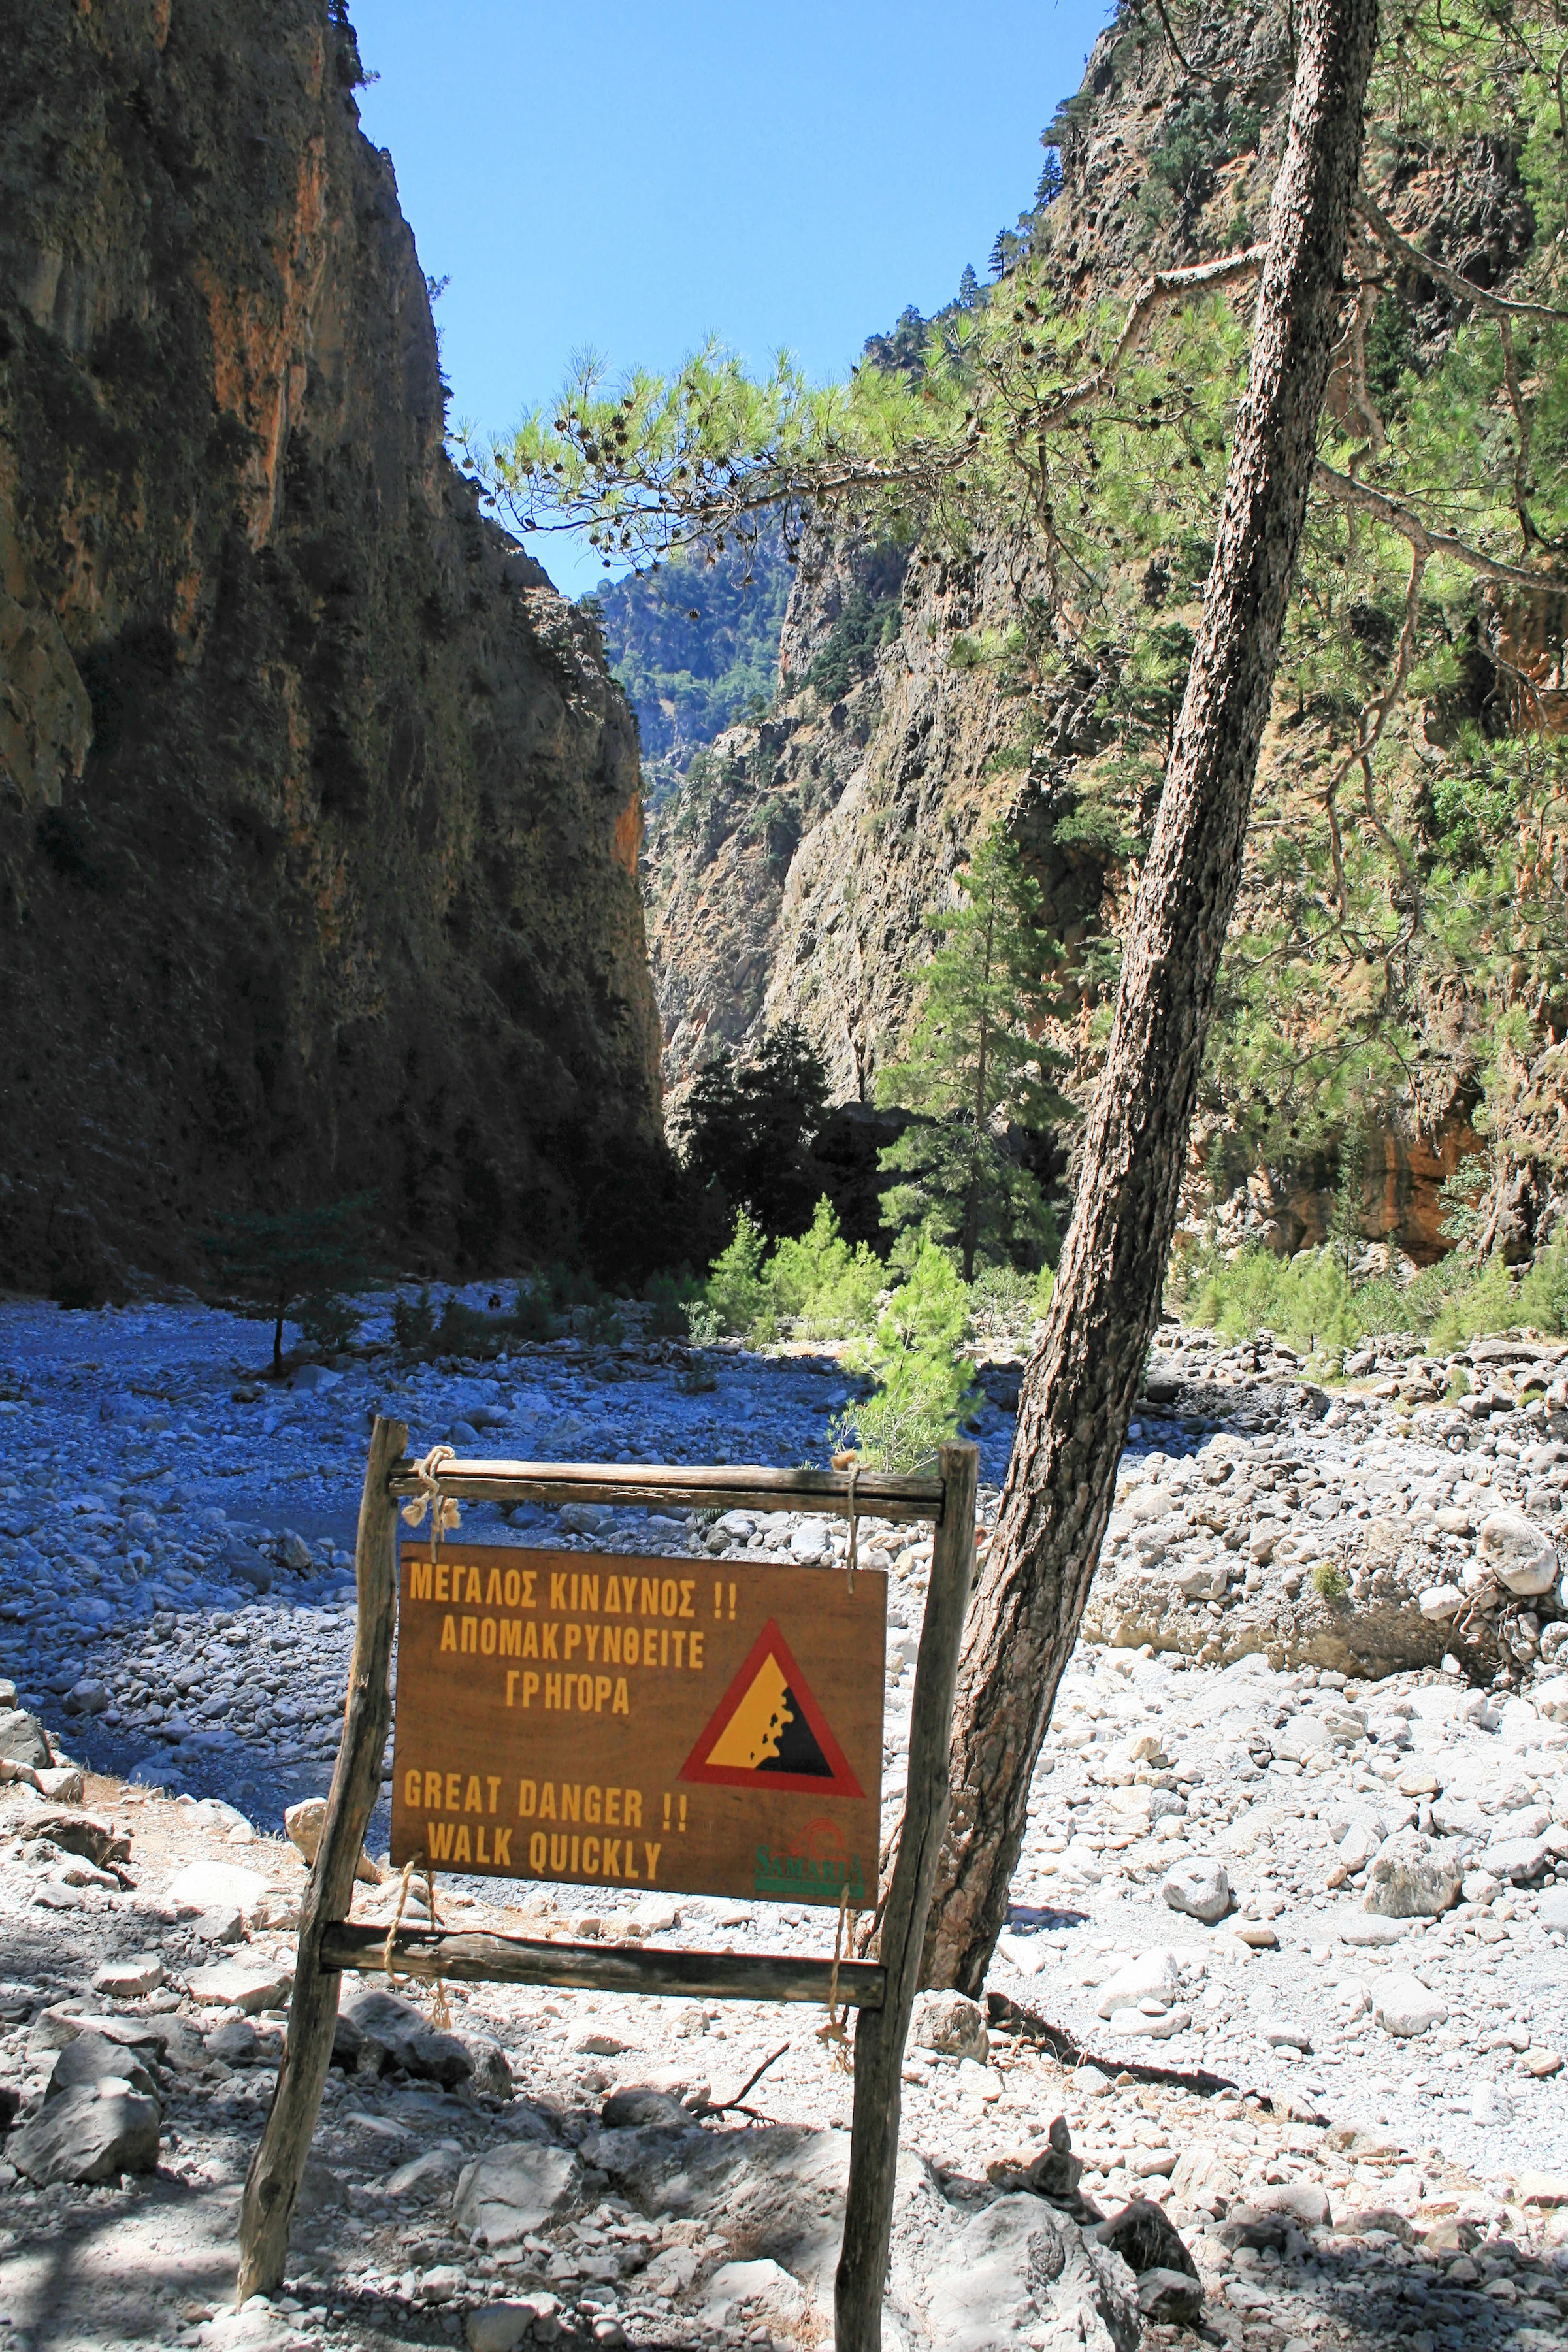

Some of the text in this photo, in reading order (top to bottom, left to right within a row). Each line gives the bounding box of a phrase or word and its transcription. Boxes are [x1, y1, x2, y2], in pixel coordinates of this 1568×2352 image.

[410, 1562, 737, 1620] ΜΕΓΑΛΟΣ ΚΙΝΔΥΝΟΣ !!
[440, 1615, 704, 1669] ΑΠΟΜΑΚΡΥΝΘΕΙΤΕ
[506, 1670, 629, 1715] ΓΡΗΓΟΡΑ
[404, 1769, 688, 1831] GREAT DANGER !!
[428, 1822, 661, 1880] WALK QUICKLY
[755, 1844, 863, 1882] SAMARIA
